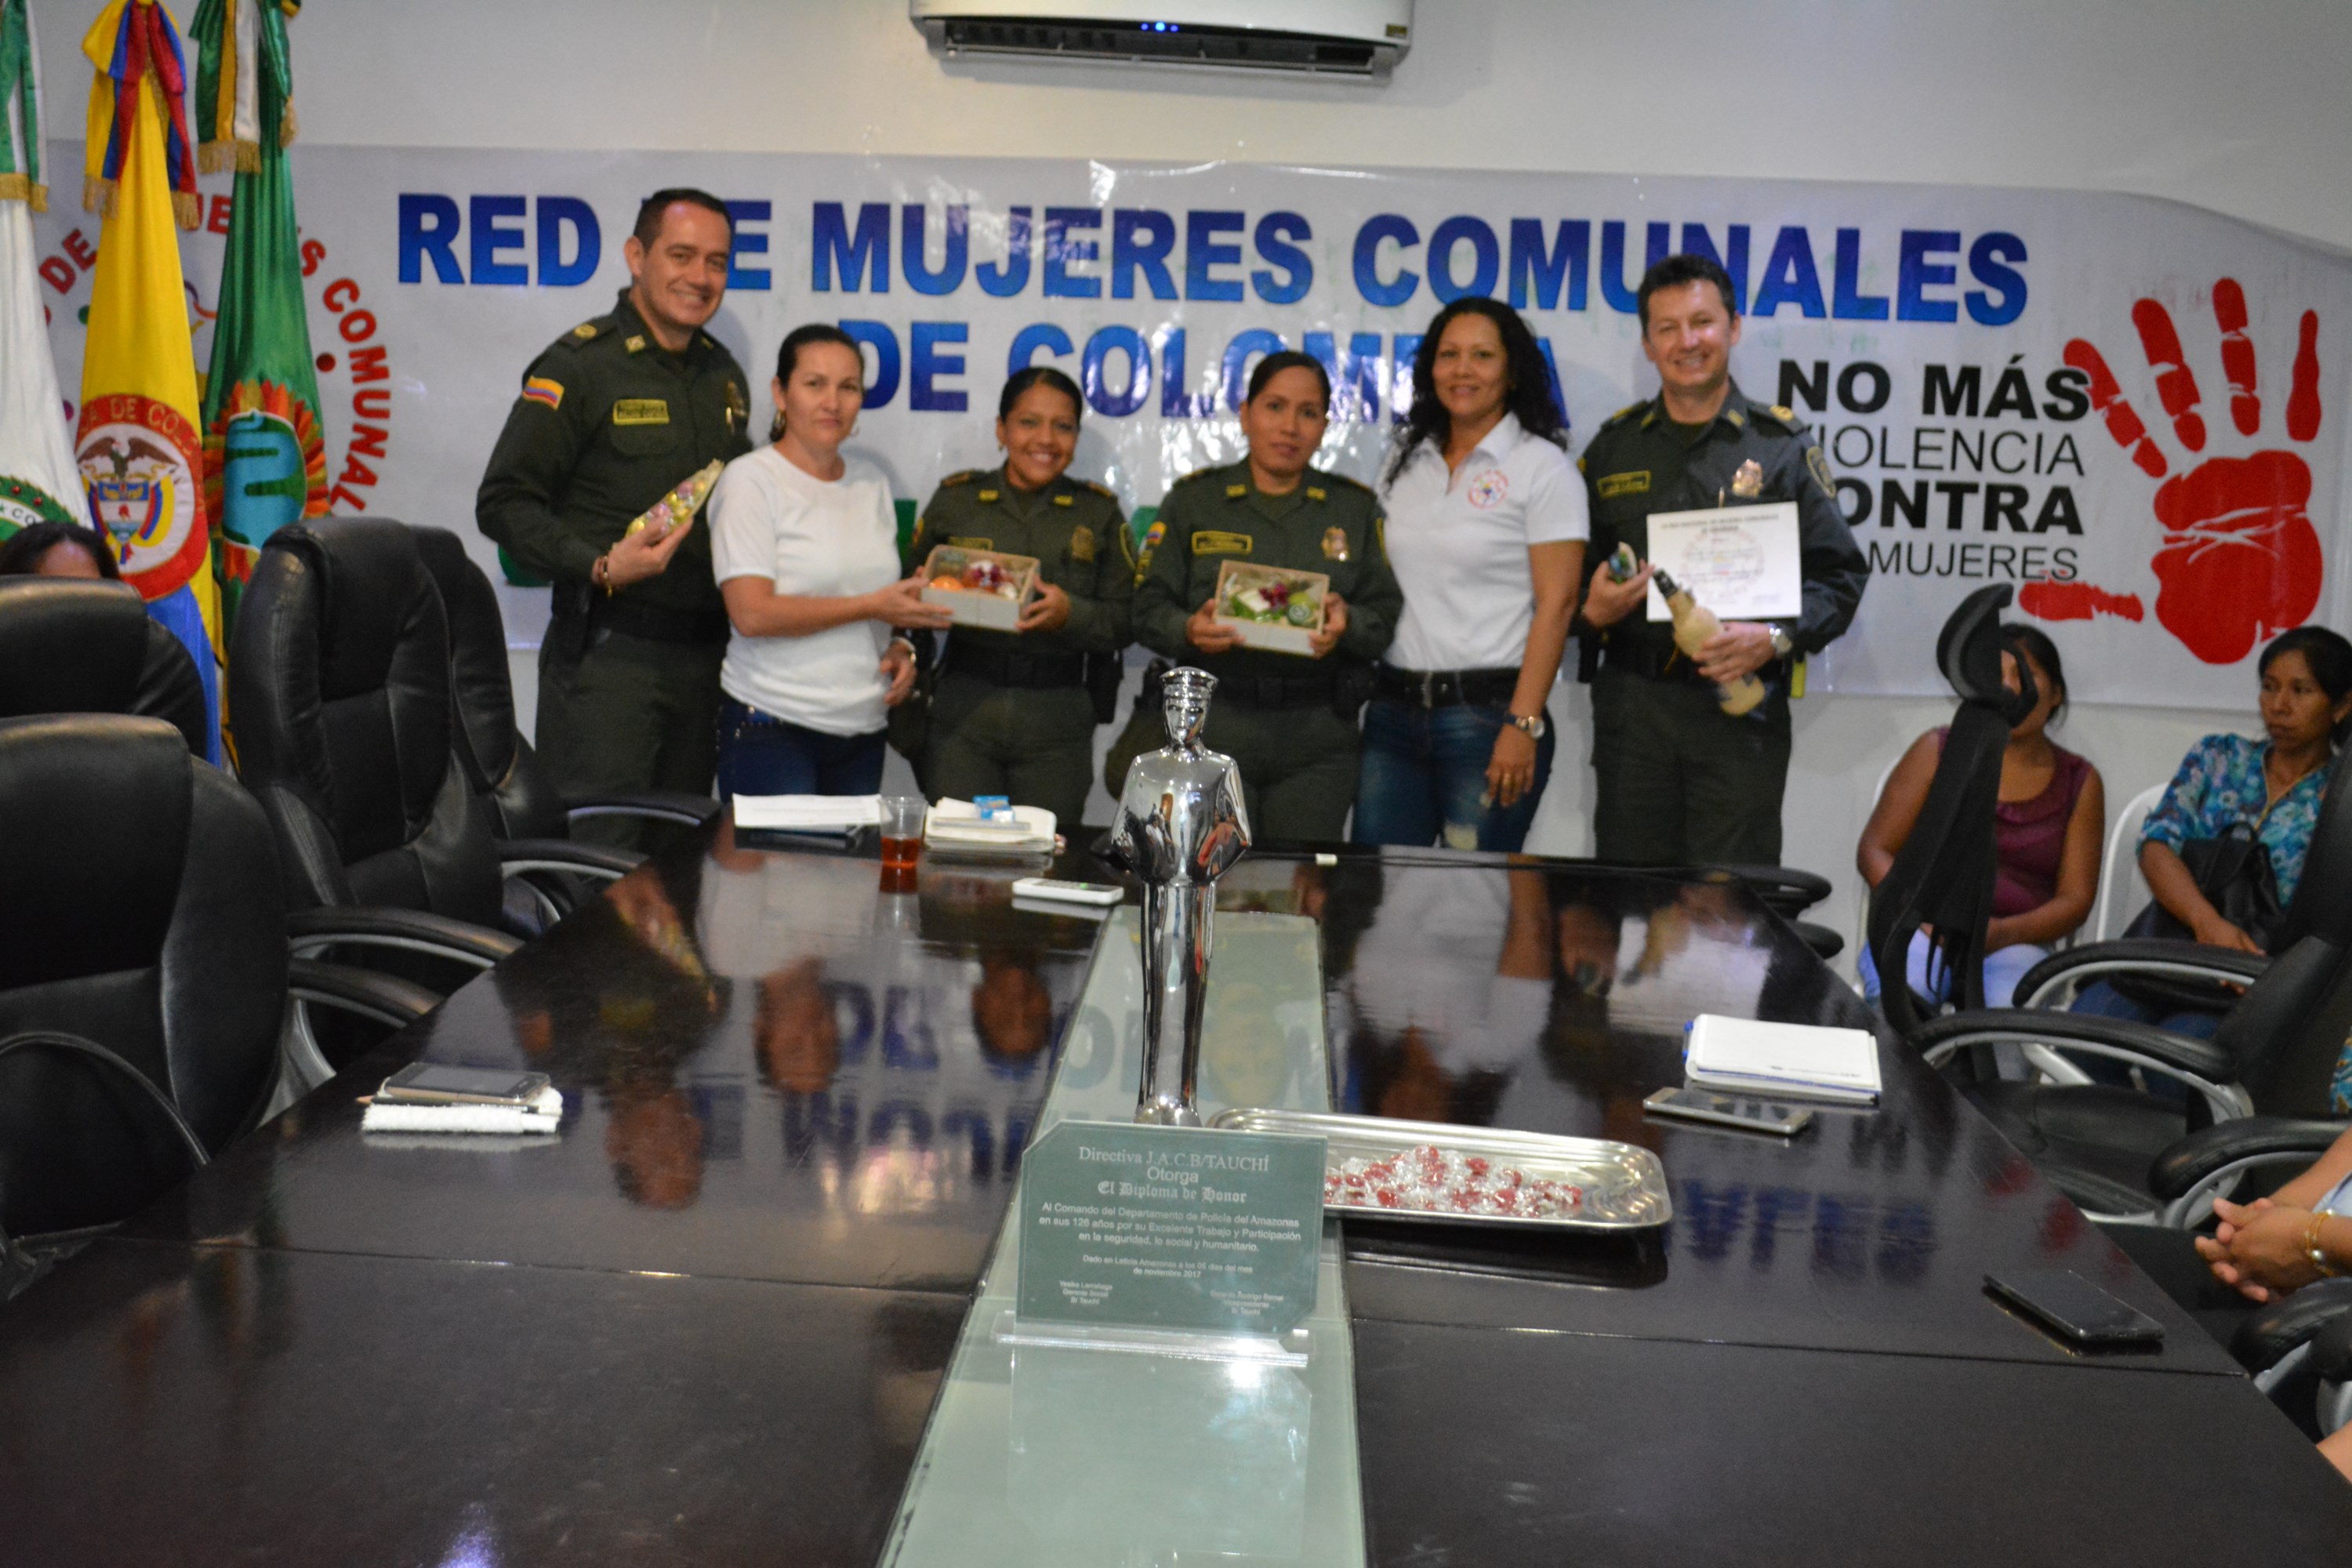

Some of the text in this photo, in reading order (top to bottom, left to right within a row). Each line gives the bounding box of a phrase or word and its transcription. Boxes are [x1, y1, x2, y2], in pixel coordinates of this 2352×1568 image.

[38, 228, 98, 295] DE
[397, 192, 602, 287] RED
[811, 201, 1313, 305] MUJERES
[1352, 212, 2028, 326] COMUNALES
[838, 319, 969, 412] DE
[1777, 354, 2090, 422] NO MÁS
[323, 278, 390, 510] COMUNAL
[1807, 424, 2085, 477] IOLENCIA
[1834, 477, 2085, 535] ONTRA
[1867, 540, 2078, 581] MUJERES
[1080, 1146, 1142, 1163] Directiva
[1147, 1167, 1199, 1185] Otorga
[1042, 1202, 1052, 1211] Al
[1054, 1203, 1099, 1214] Comando
[1102, 1206, 1116, 1215] del
[1118, 1207, 1184, 1220] Departamento
[1186, 1212, 1198, 1221] de
[1234, 1214, 1248, 1224] del
[1250, 1215, 1300, 1228] Amazonas
[1098, 1180, 1247, 1203] El Diploma de Honor
[1039, 1217, 1051, 1225] en
[1054, 1218, 1069, 1226] sus
[1073, 1218, 1090, 1227] 126
[1092, 1218, 1115, 1229] años
[1117, 1221, 1133, 1232] por
[1149, 1222, 1194, 1234] Excelente
[1197, 1225, 1232, 1237] Trabajo
[1233, 1229, 1240, 1238] y
[1242, 1228, 1301, 1241] Participación
[1079, 1232, 1091, 1241] en
[1093, 1232, 1102, 1242] la
[1155, 1236, 1163, 1246] lo
[1166, 1236, 1192, 1247] social
[1194, 1240, 1201, 1250] y
